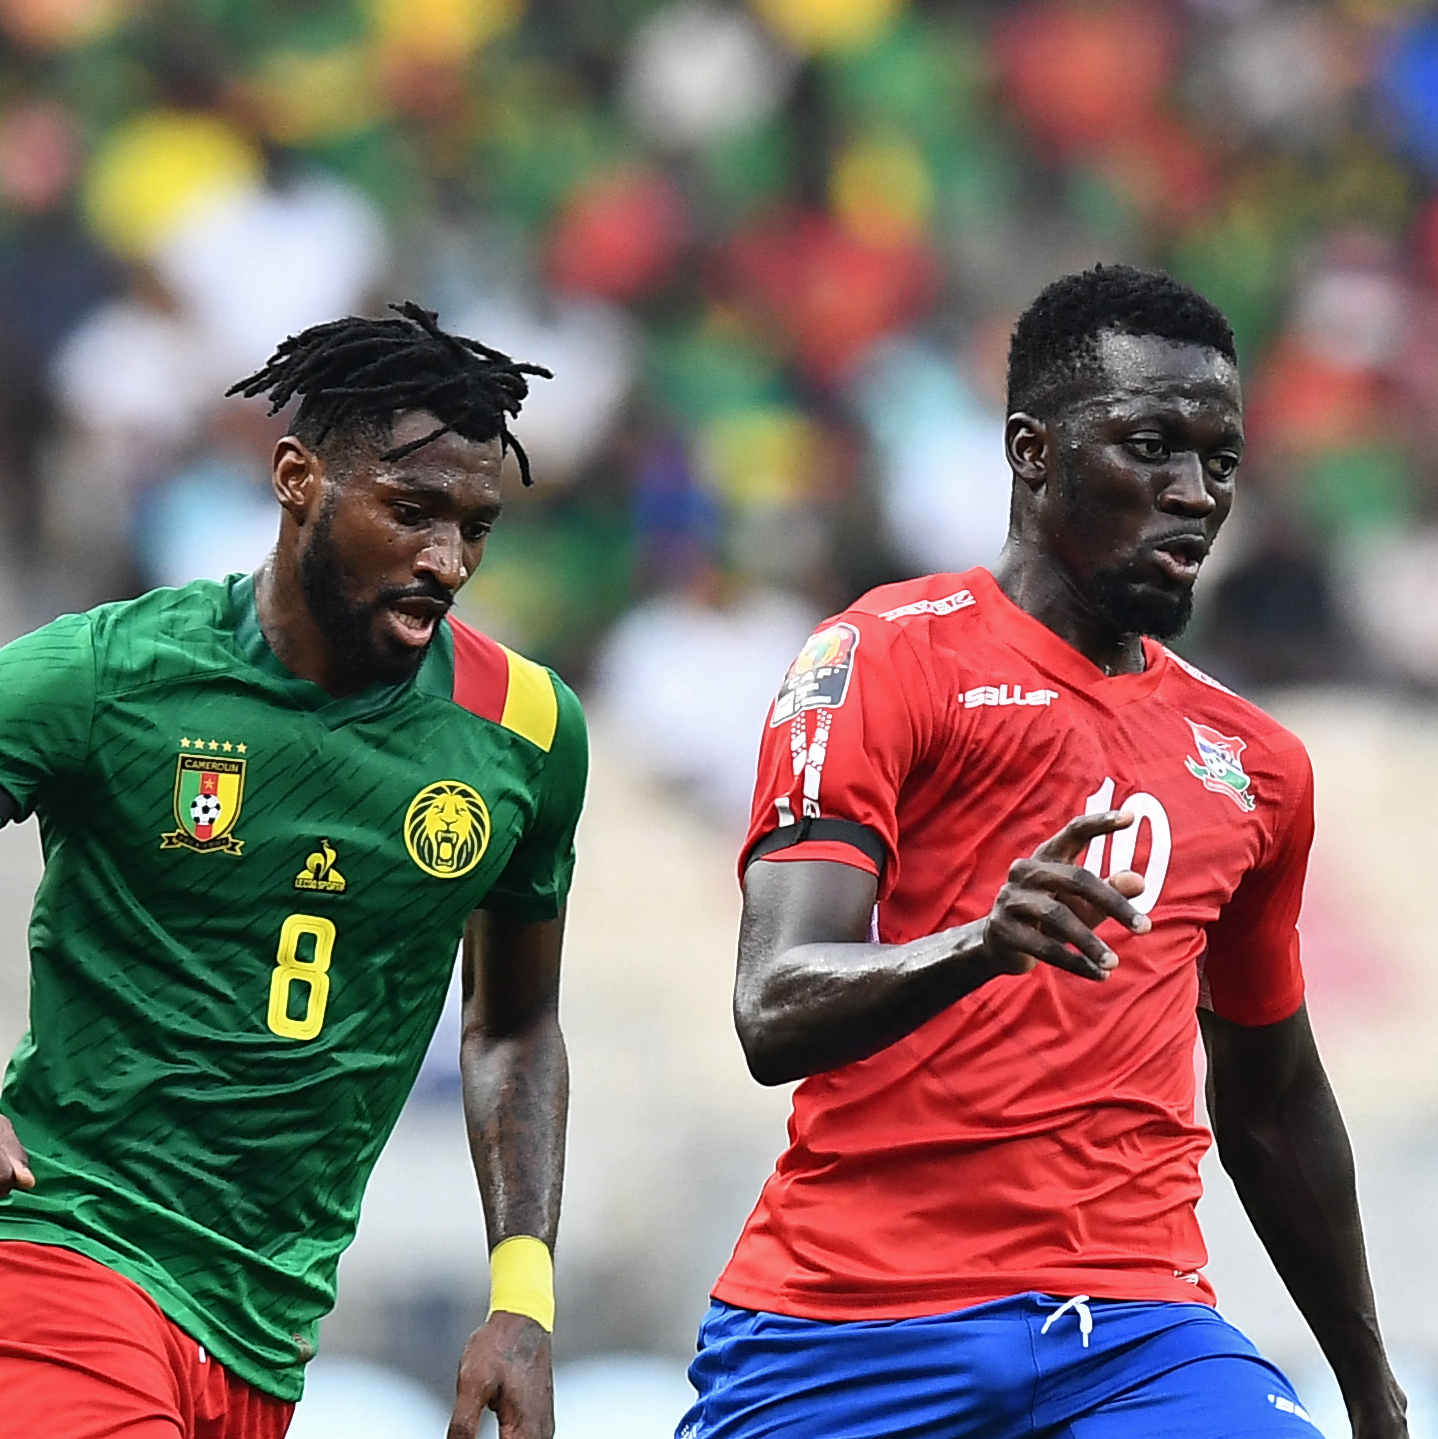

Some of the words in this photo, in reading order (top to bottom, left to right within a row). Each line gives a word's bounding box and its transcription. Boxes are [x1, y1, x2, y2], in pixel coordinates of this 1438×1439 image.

[183, 758, 240, 773] CAMEROUN
[1082, 776, 1172, 915] 10
[267, 913, 336, 1041] 8
